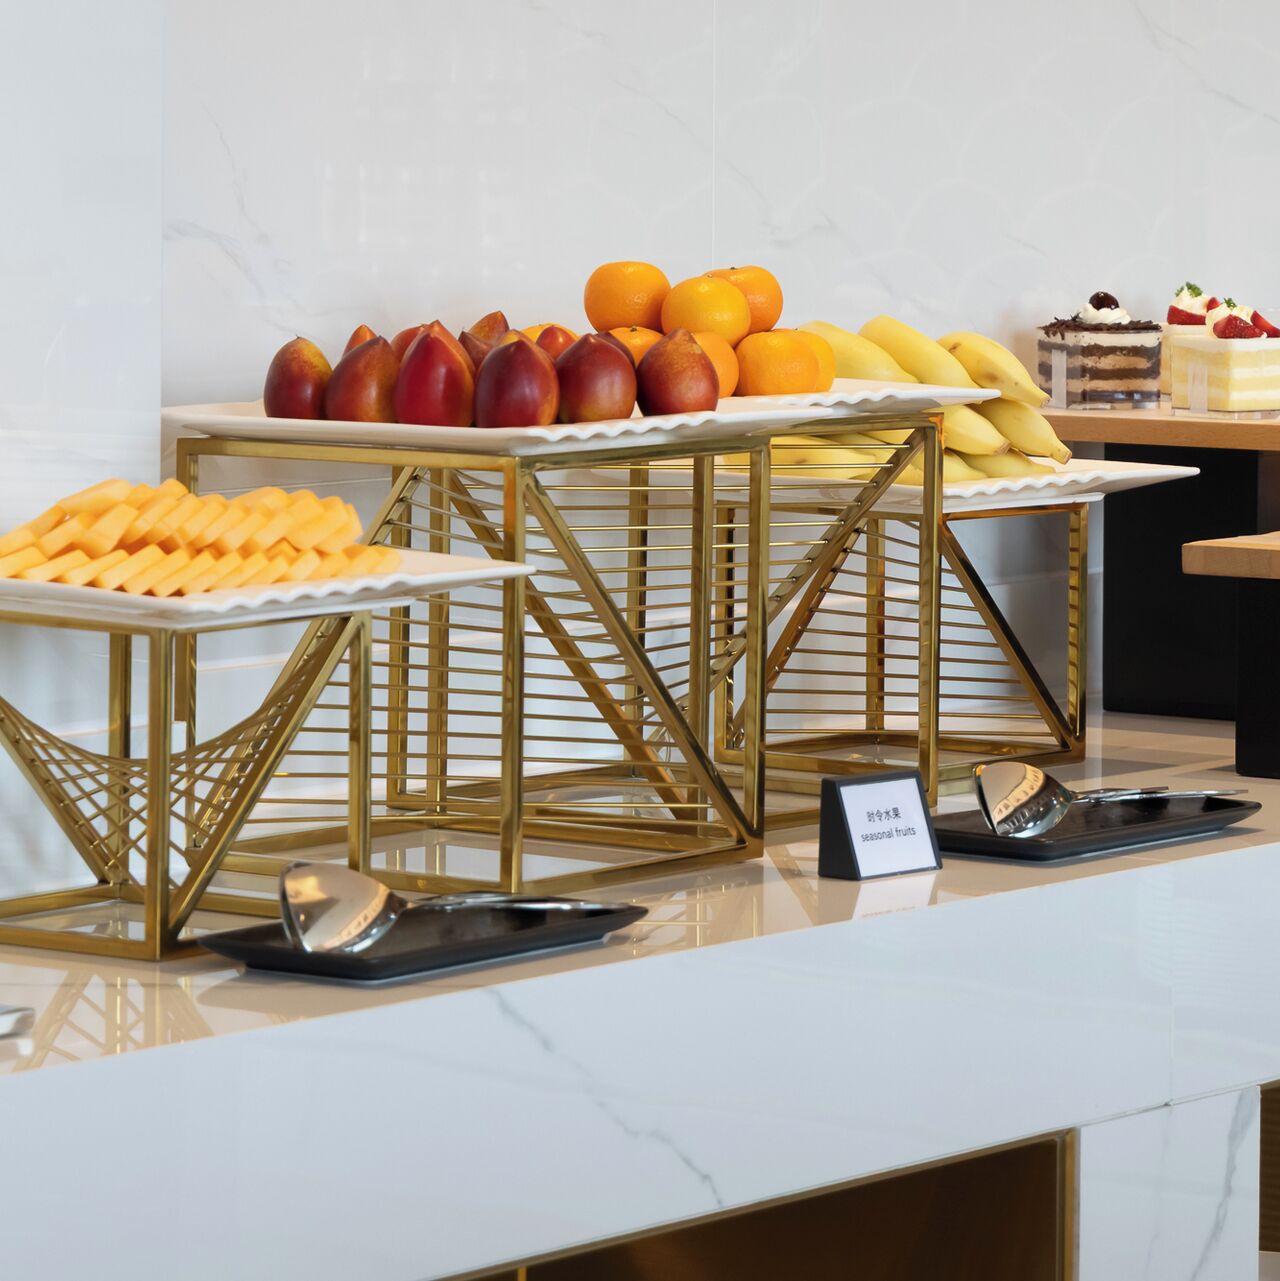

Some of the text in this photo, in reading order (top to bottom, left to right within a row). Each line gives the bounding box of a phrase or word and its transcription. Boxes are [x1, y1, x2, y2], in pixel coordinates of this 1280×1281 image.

[866, 807, 902, 823] 时令水果
[861, 825, 917, 842] seasonal fruits
